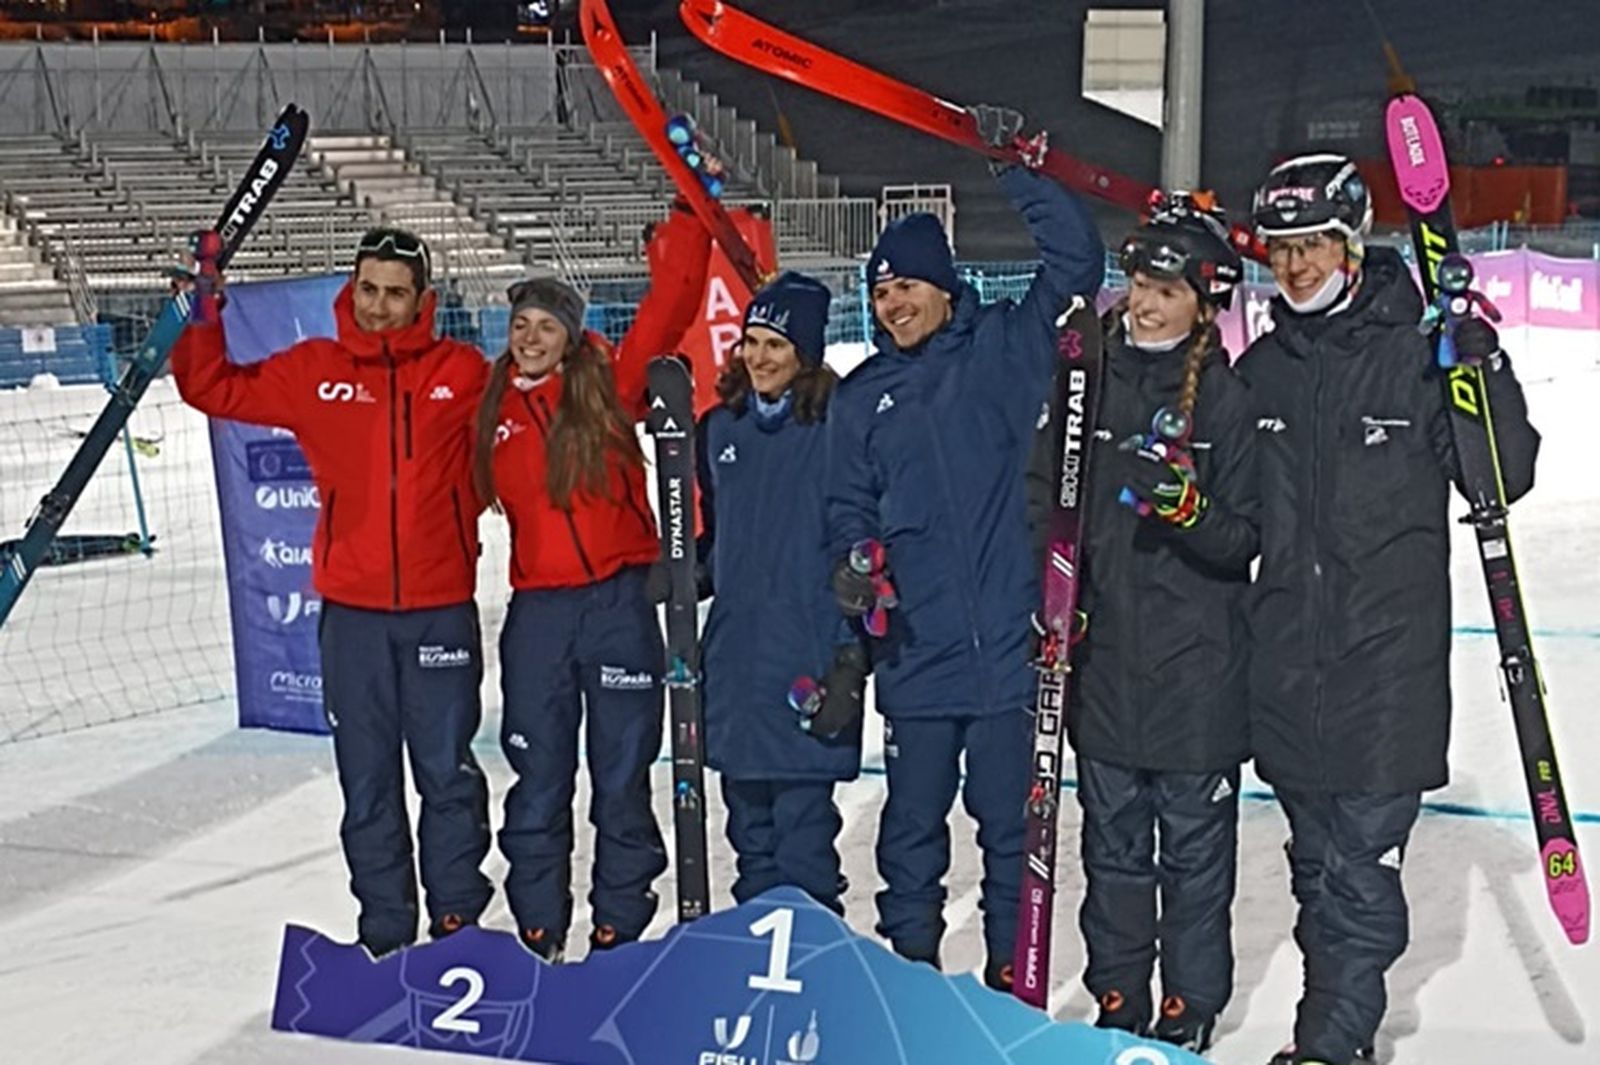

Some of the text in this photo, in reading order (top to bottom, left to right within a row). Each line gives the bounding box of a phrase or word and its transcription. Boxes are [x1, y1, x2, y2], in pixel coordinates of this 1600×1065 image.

[752, 38, 813, 69] ATOMIC
[669, 477, 684, 559] DYNASTAR
[1550, 852, 1575, 876] 64
[749, 908, 802, 993] 1
[432, 967, 485, 1033] 2
